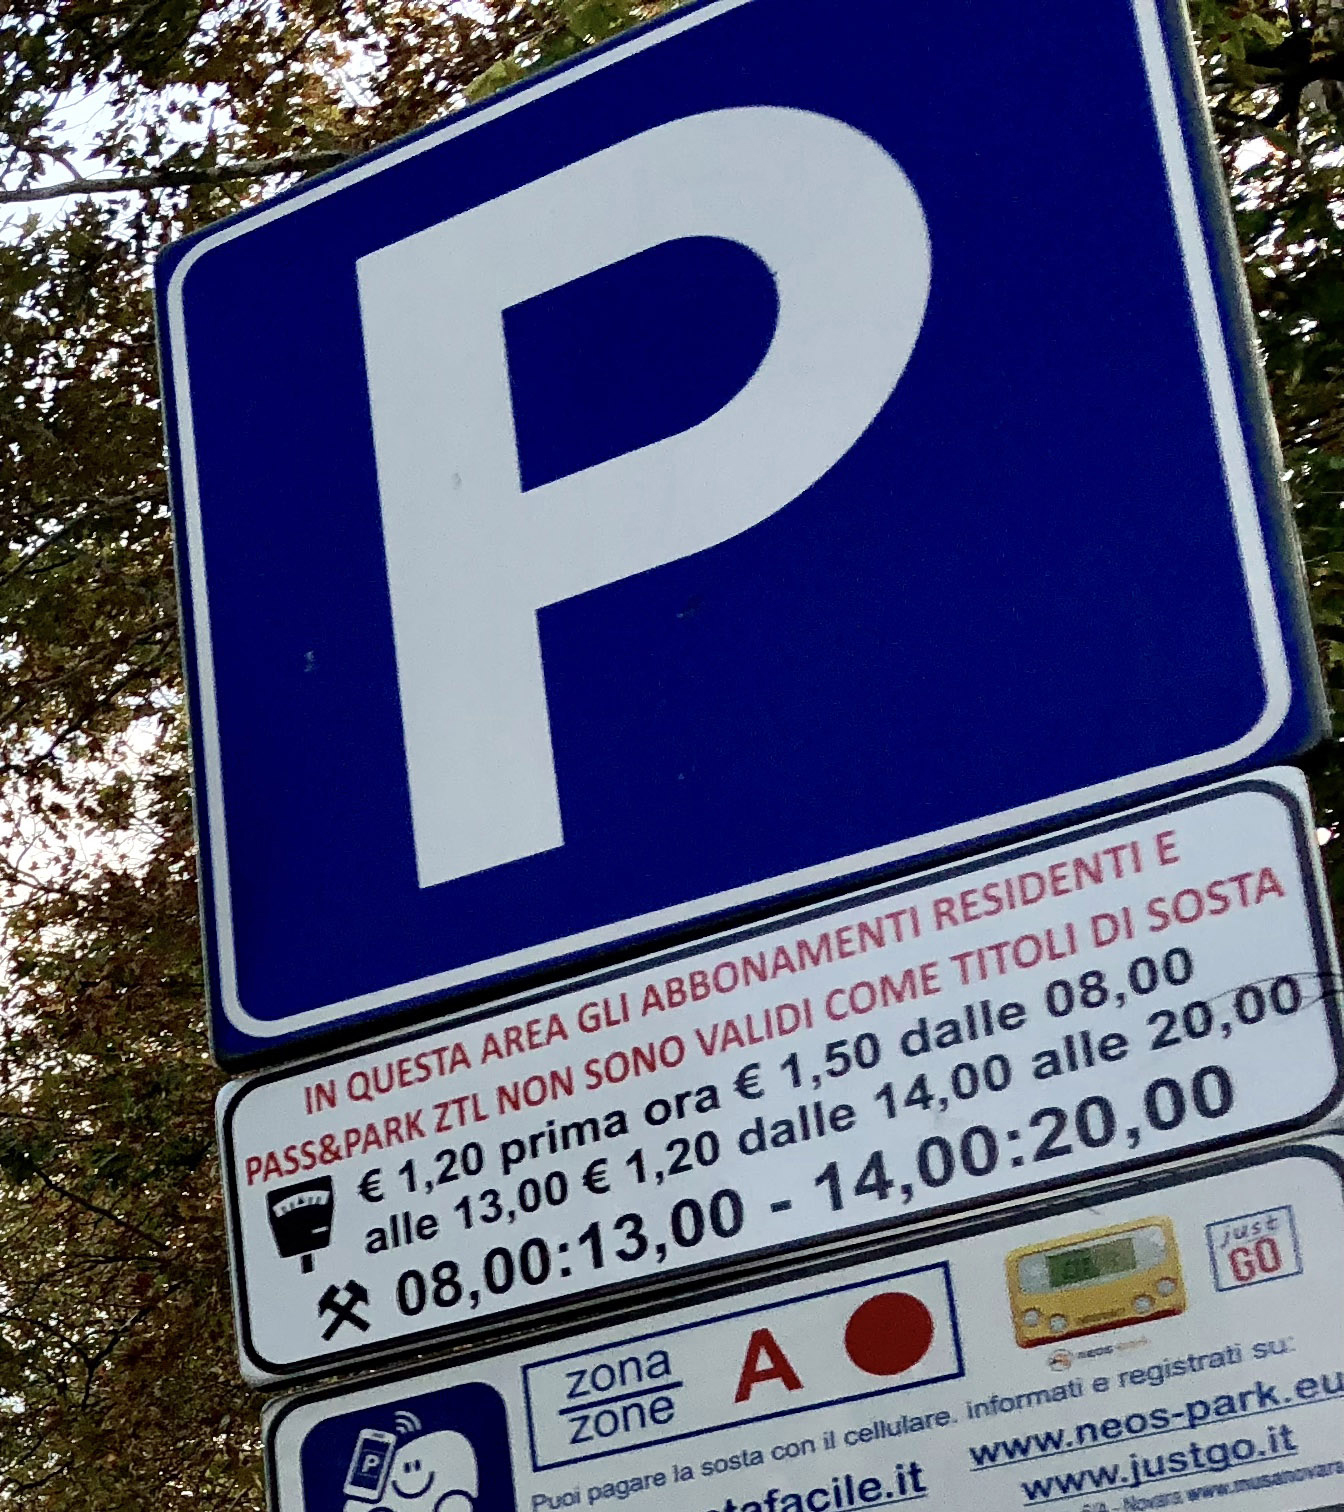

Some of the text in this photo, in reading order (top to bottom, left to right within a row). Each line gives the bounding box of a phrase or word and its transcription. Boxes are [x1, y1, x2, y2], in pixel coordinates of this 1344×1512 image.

[356, 106, 932, 888] P
[244, 865, 1286, 1186] PASS&PARK ZTL NON SONO VALIDI COME TITOLI DI SOSTA
[304, 829, 1181, 1115] IN QUESTA AREA GLI ABBONAMENTI RESIDENTI E
[357, 945, 1195, 1203] € 1,20 prima ora € 1,50 dalle 08,00
[364, 973, 1303, 1255] alle 13,00 € 1,20 dalle 14,00 alle 20,00
[395, 1064, 1235, 1318] 08,00:13,00 - 14,00:20,00
[1220, 1213, 1280, 1249] just
[1227, 1237, 1284, 1283] GO
[565, 1326, 806, 1405] zona A
[568, 1394, 676, 1446] zone
[587, 1470, 667, 1506] pagare
[673, 1462, 695, 1484] la
[701, 1448, 765, 1478] sosta
[770, 1438, 816, 1464] con
[822, 1428, 838, 1452] il
[843, 1406, 958, 1446] cellulare.
[967, 1376, 1083, 1420] informati
[1092, 1376, 1111, 1396] e
[1118, 1342, 1243, 1391] registrati
[969, 1370, 1344, 1467] www.neos-park.eu
[361, 1454, 380, 1473] P
[1021, 1423, 1298, 1500] www.justgo.it
